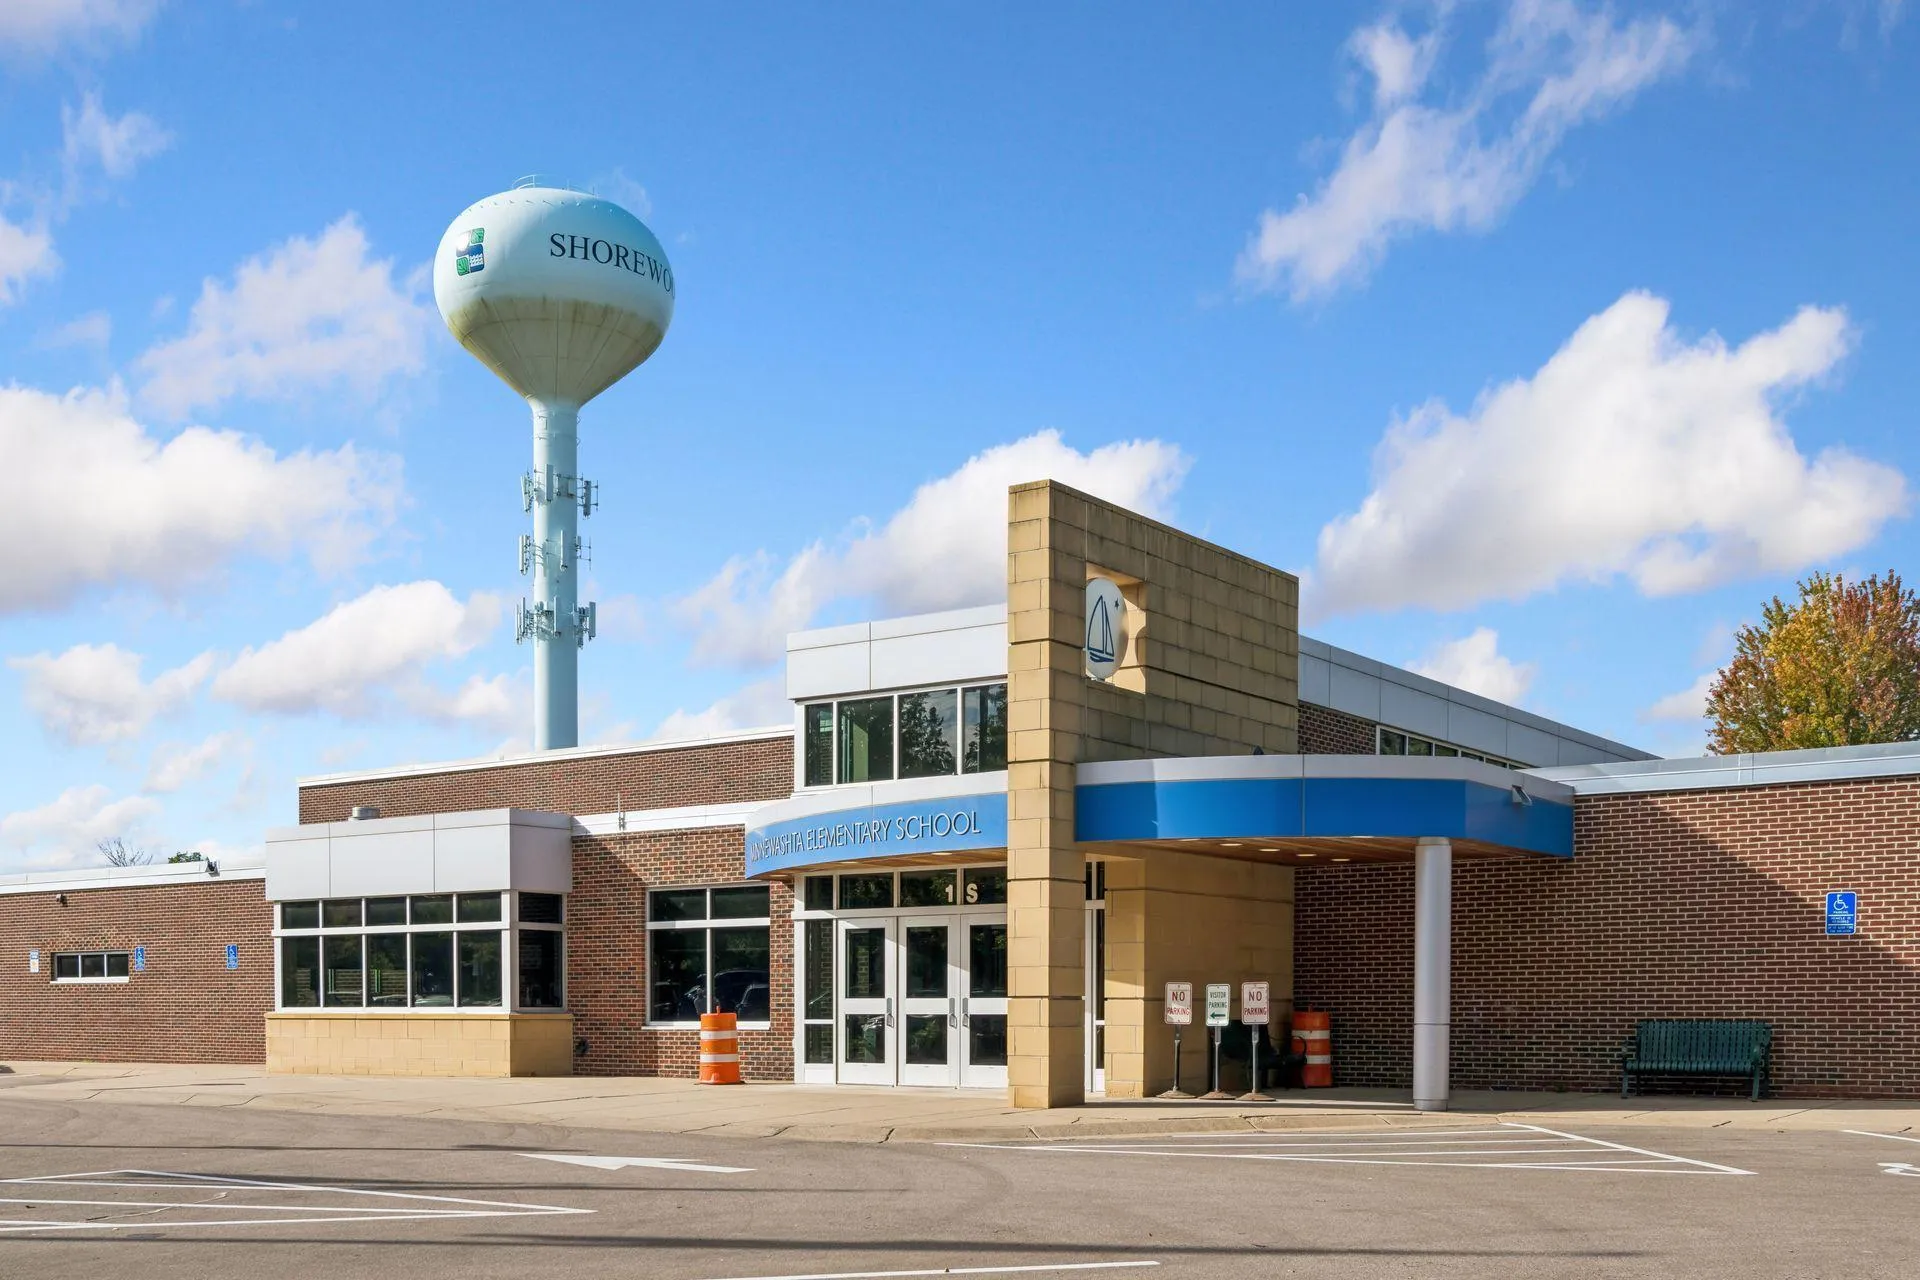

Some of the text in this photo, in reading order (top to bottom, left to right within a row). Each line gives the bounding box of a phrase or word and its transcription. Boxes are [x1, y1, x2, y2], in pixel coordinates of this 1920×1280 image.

[806, 818, 892, 851] ELEMENTARY
[895, 810, 982, 841] SCHOOL
[945, 883, 978, 903] 1 S
[1171, 991, 1186, 1002] NO
[1209, 991, 1227, 999] VISITOR
[1248, 990, 1263, 1002] NO
[1208, 1001, 1228, 1009] PARKING
[1167, 1007, 1190, 1016] PARKING
[1244, 1006, 1268, 1016] PARKING
